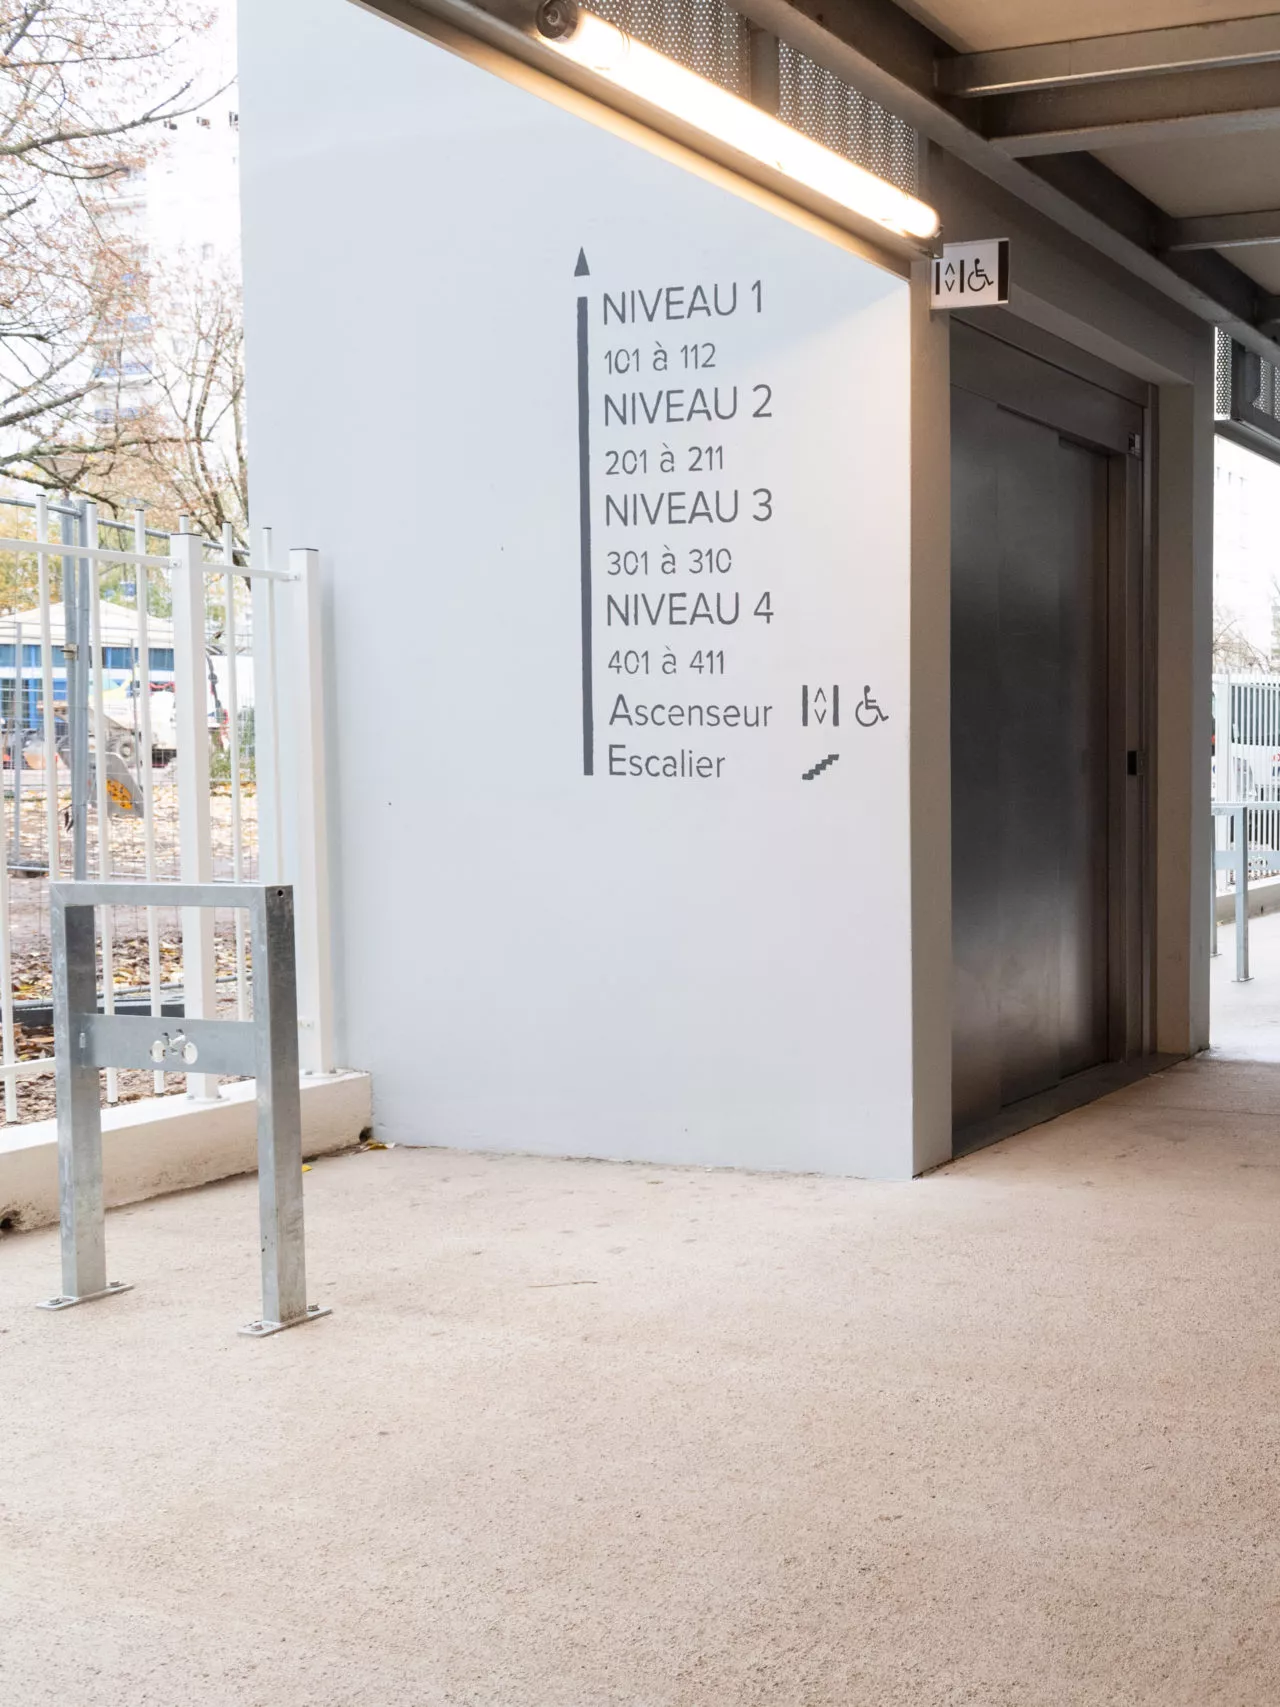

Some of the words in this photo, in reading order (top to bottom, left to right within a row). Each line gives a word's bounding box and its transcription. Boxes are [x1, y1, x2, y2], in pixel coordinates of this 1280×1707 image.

[602, 282, 738, 326] NIVEAU
[751, 279, 763, 314] 1
[603, 347, 640, 375] 101
[652, 341, 668, 372] à
[680, 342, 717, 371] 112
[604, 385, 738, 427] NIVEAU
[751, 383, 773, 419] 2
[604, 449, 648, 476] 201
[660, 442, 675, 474] à
[687, 445, 724, 472] 211
[605, 489, 739, 527] NIVEAU
[752, 487, 773, 522] 3
[607, 550, 649, 576] 301
[660, 544, 677, 575] à
[688, 547, 732, 574] 310
[606, 592, 740, 627] NIVEAU
[753, 591, 774, 625] 4
[607, 649, 650, 675] 401
[661, 645, 677, 675] à
[689, 649, 725, 675] 411
[608, 693, 773, 728] Ascenseur
[608, 743, 726, 779] Escalier
